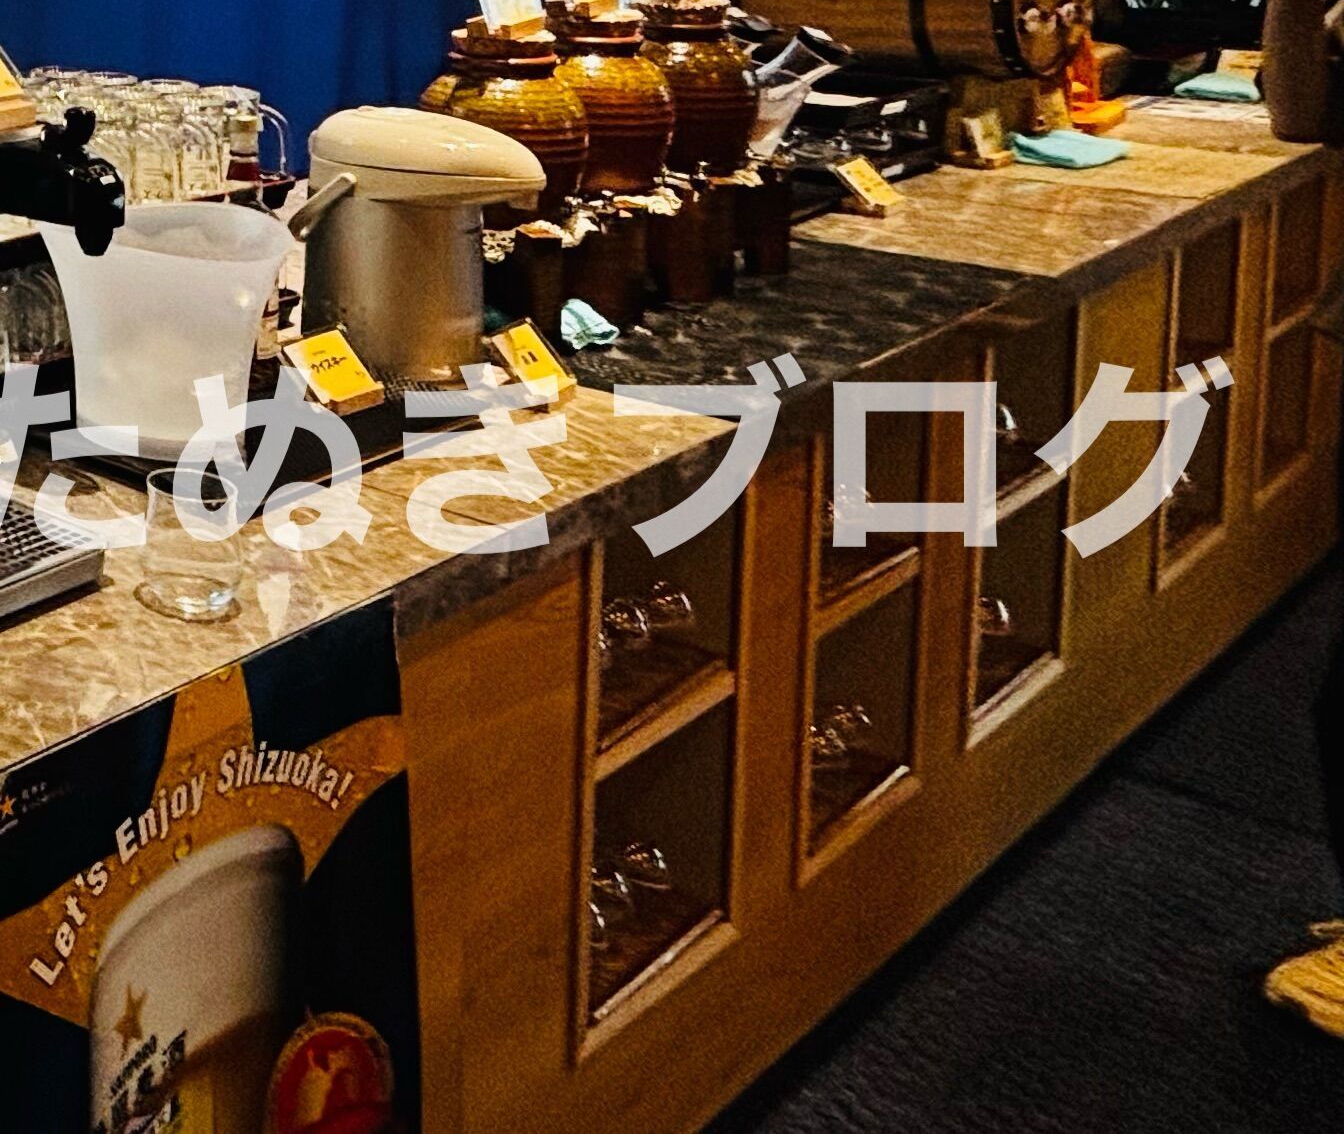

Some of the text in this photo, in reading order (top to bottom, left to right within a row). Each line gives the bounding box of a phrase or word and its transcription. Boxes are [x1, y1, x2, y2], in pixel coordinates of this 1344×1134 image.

[29, 861, 110, 987] Let's
[115, 770, 209, 865] Enjoy
[219, 739, 354, 811] Shizuoka!
